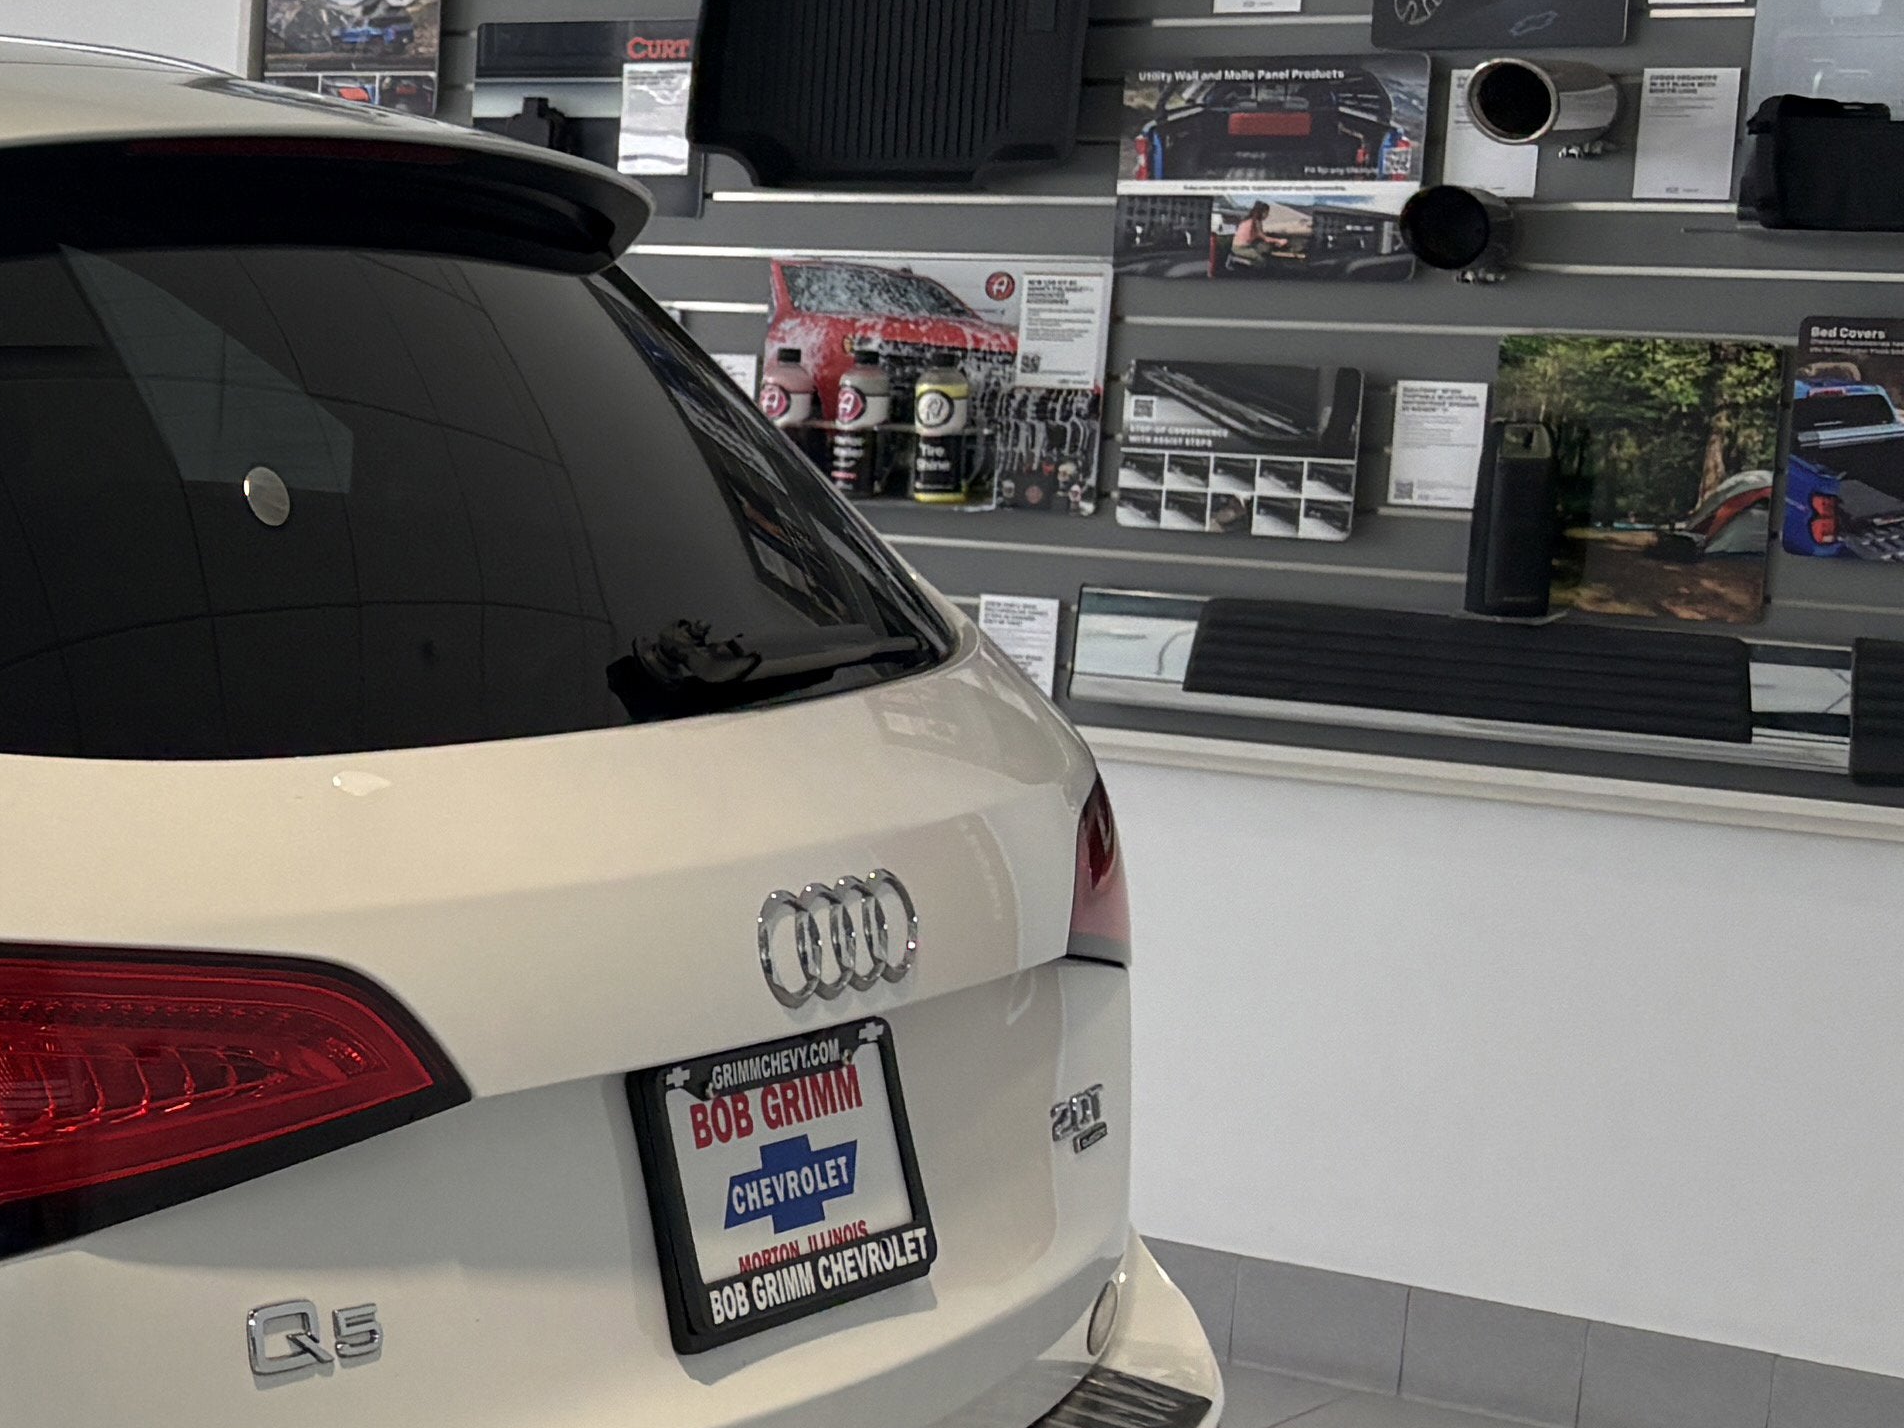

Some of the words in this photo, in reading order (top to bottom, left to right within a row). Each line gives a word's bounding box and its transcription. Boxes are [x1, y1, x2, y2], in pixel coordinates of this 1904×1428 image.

[626, 36, 691, 60] CURT
[1138, 71, 1173, 83] Utility
[1174, 70, 1199, 81] Wall
[1200, 70, 1222, 81] and
[1257, 69, 1290, 80] Panel
[1291, 68, 1345, 80] Products
[1810, 326, 1838, 338] Bed
[1839, 327, 1886, 340] Covers
[918, 443, 945, 458] Tire
[711, 1037, 840, 1090] GRIMMCHEVY.COM
[689, 1090, 754, 1150] BOB
[759, 1064, 864, 1131] GRIMM
[731, 1155, 849, 1215] CHEVROLET
[807, 1219, 869, 1252] ILLINOIS
[709, 1280, 750, 1325] BOB
[751, 1260, 817, 1309] GRIMM
[817, 1226, 928, 1290] CHEVROLET
[246, 1299, 384, 1377] Q5
